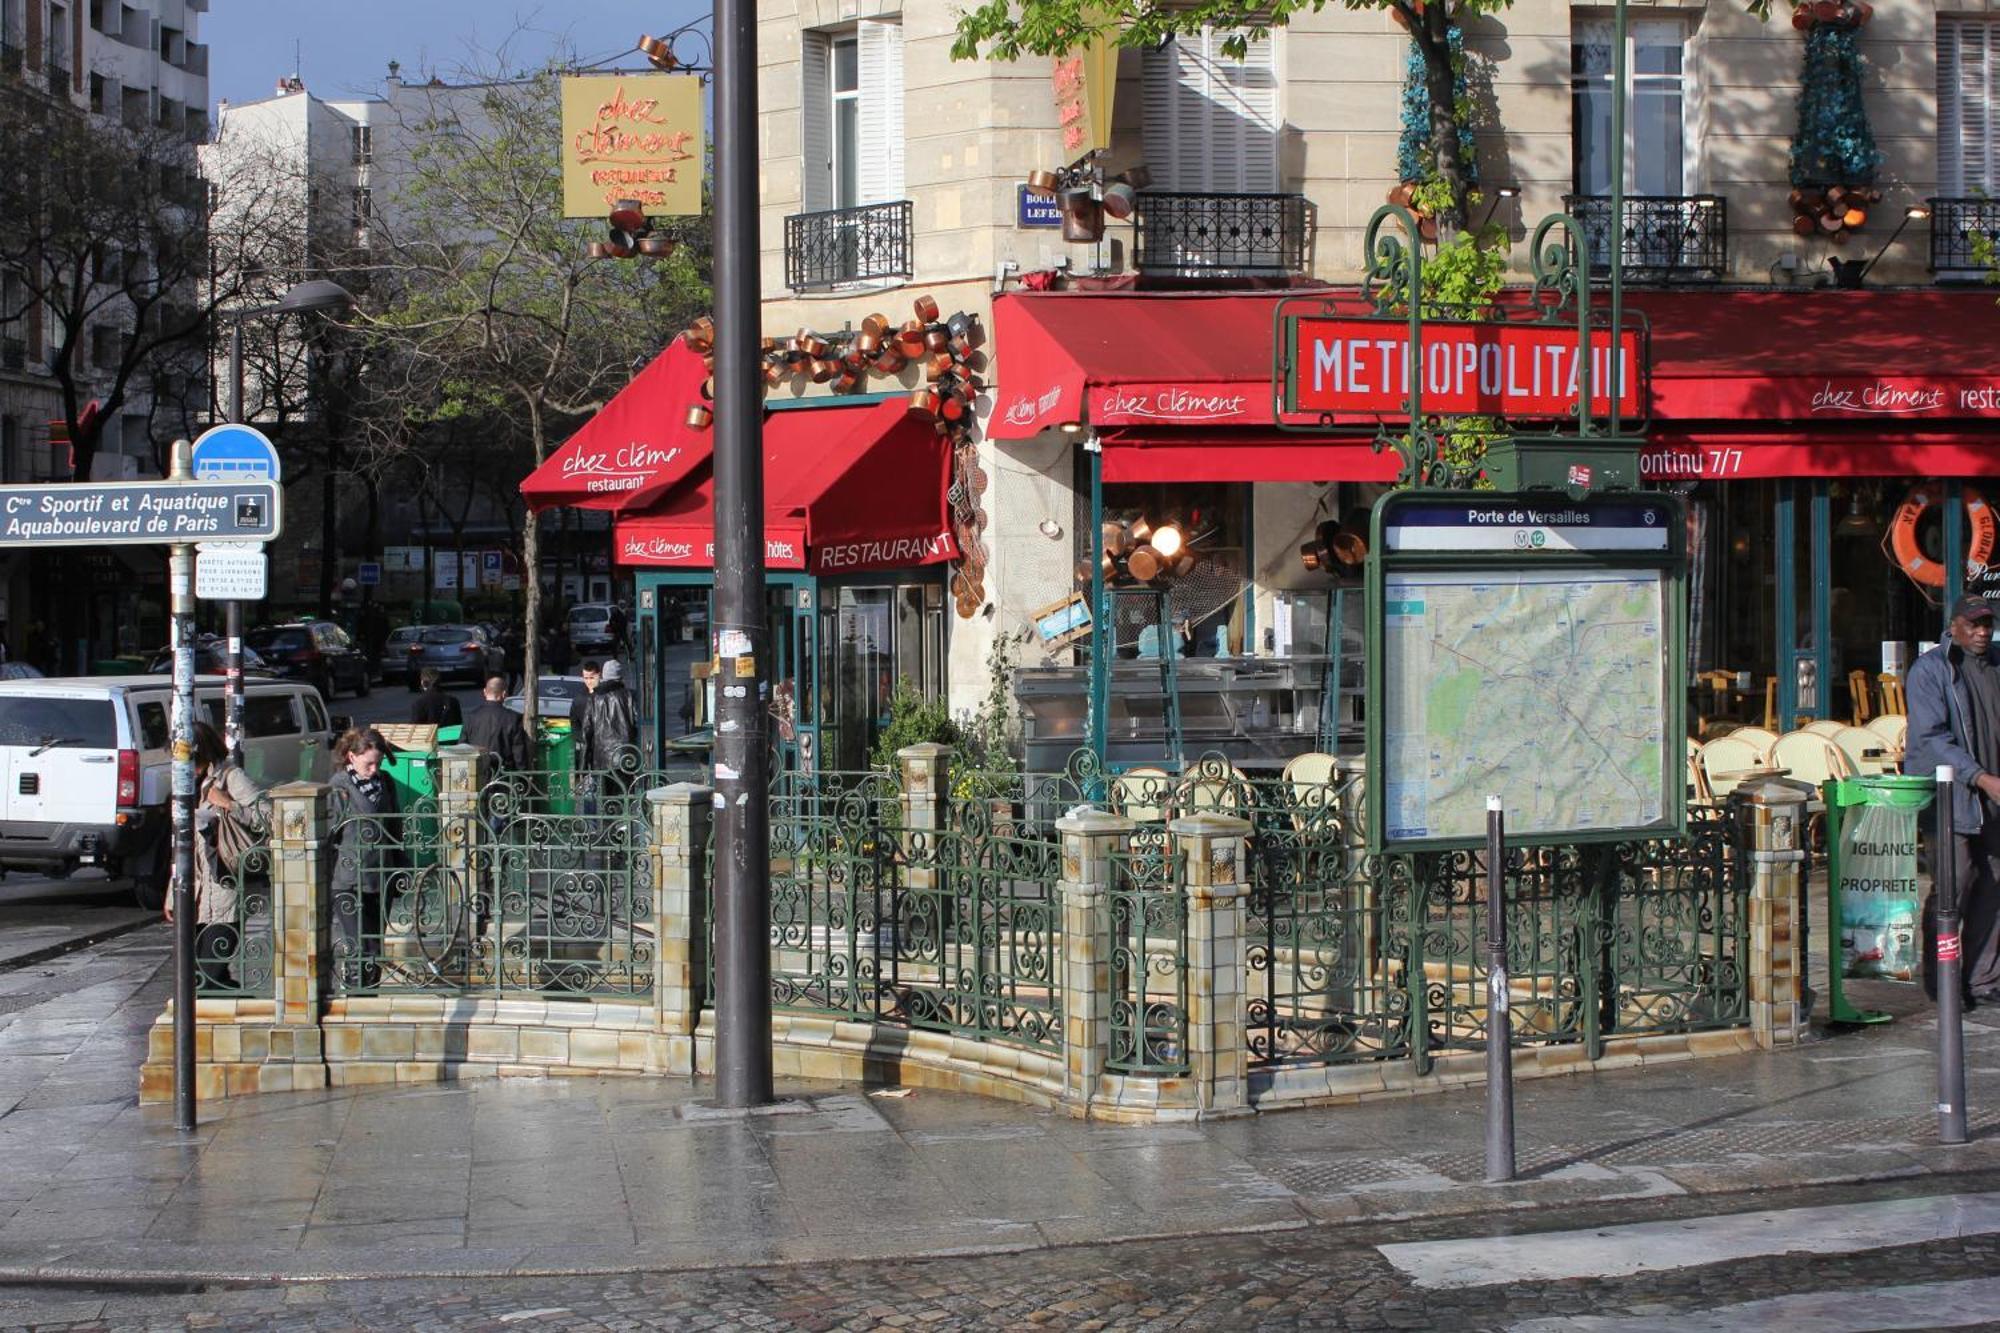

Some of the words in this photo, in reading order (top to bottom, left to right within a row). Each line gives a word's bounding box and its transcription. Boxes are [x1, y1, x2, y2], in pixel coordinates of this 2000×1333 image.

[1104, 389, 1154, 413] chez
[1158, 388, 1246, 413] Clément
[1812, 381, 1860, 406] chez
[1863, 382, 1944, 406] Clément
[563, 445, 614, 472] chez
[1709, 448, 1742, 476] 7/7
[587, 476, 645, 493] restaurant
[41, 495, 103, 517] Sportif
[111, 495, 129, 512] et
[139, 493, 228, 515] Aquatique
[1468, 510, 1504, 523] Porte
[1508, 510, 1524, 523] de
[1527, 510, 1590, 523] Versailles
[7, 515, 140, 539] Aquaboulevard
[147, 517, 168, 533] de
[174, 514, 218, 532] Paris
[1533, 532, 1545, 546] 12
[625, 536, 648, 555] chez
[821, 533, 950, 568] RESTAURANT
